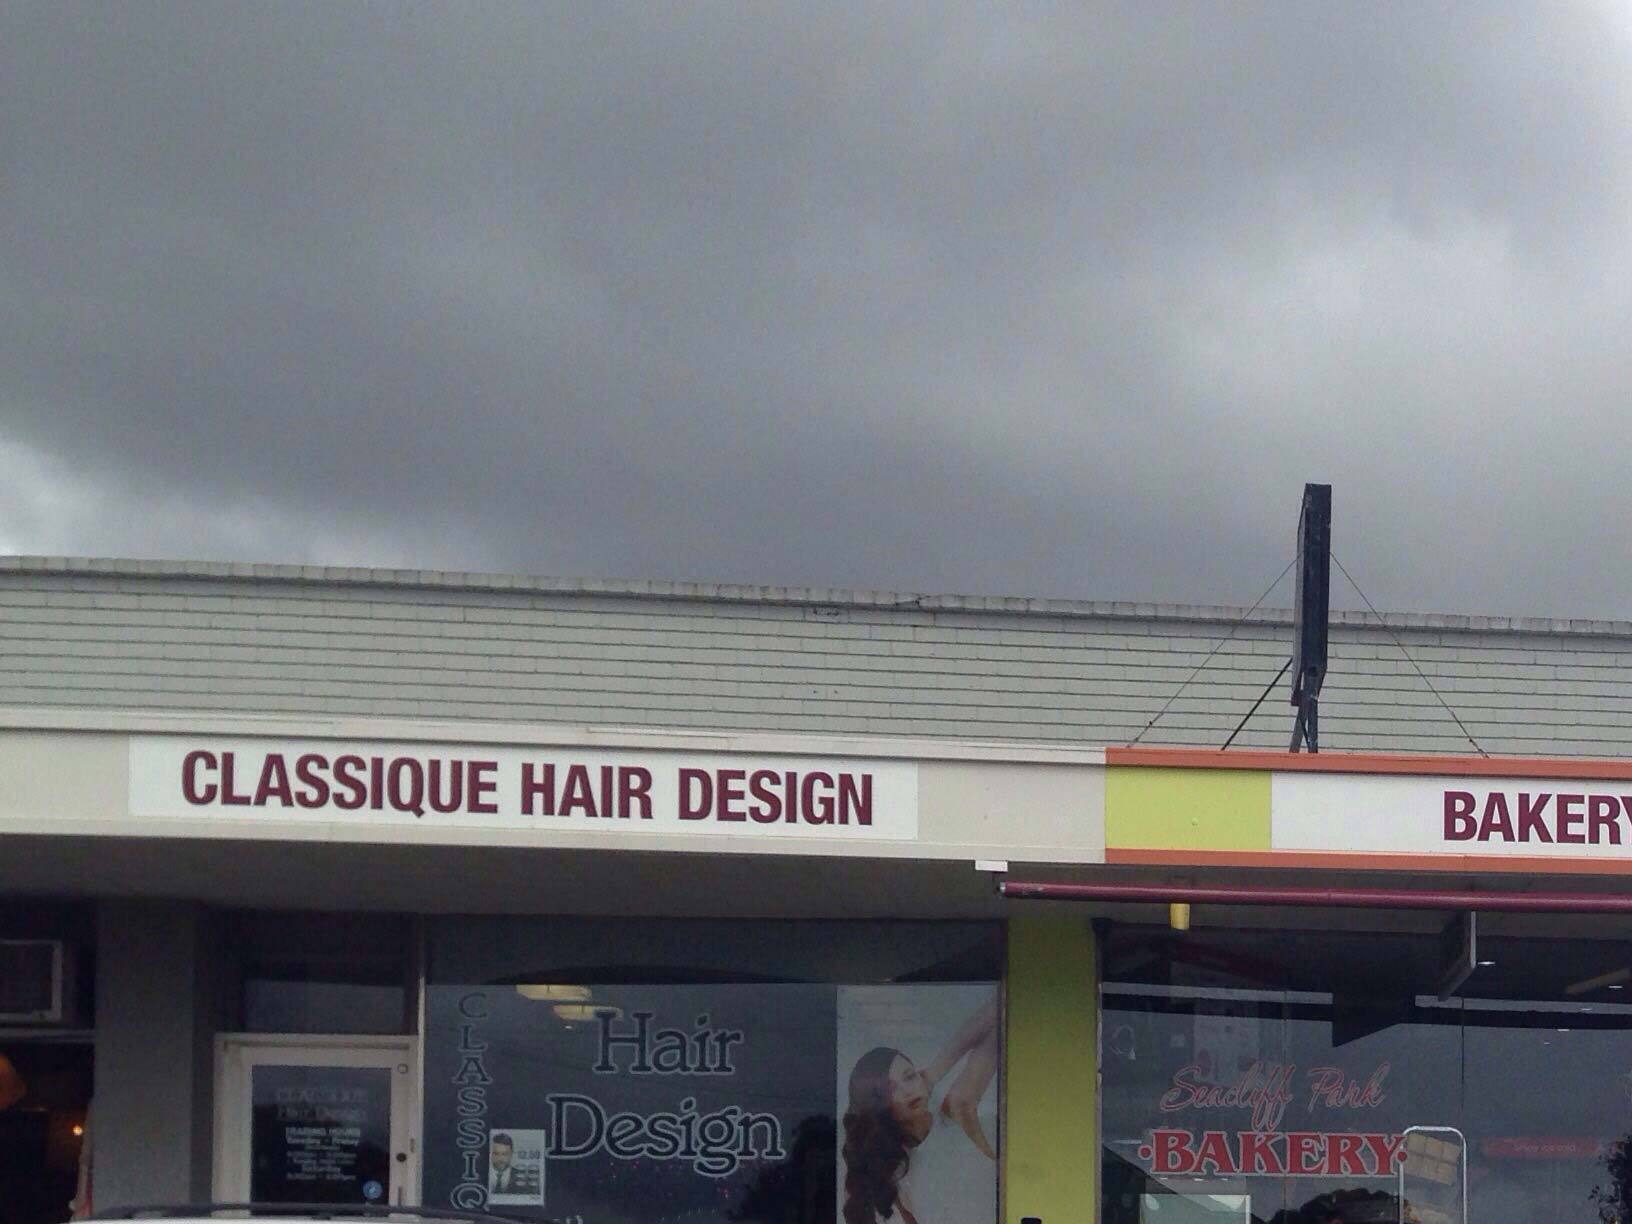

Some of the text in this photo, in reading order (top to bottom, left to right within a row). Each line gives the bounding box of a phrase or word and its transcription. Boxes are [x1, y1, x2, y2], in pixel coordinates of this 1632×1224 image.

[182, 749, 874, 826] CLASSIQUE HAIR DESIGN
[594, 1009, 744, 1075] Hair
[1160, 1062, 1392, 1132] Seacliff Park
[546, 1093, 786, 1178] Design
[1151, 1129, 1403, 1177] BAKERY
